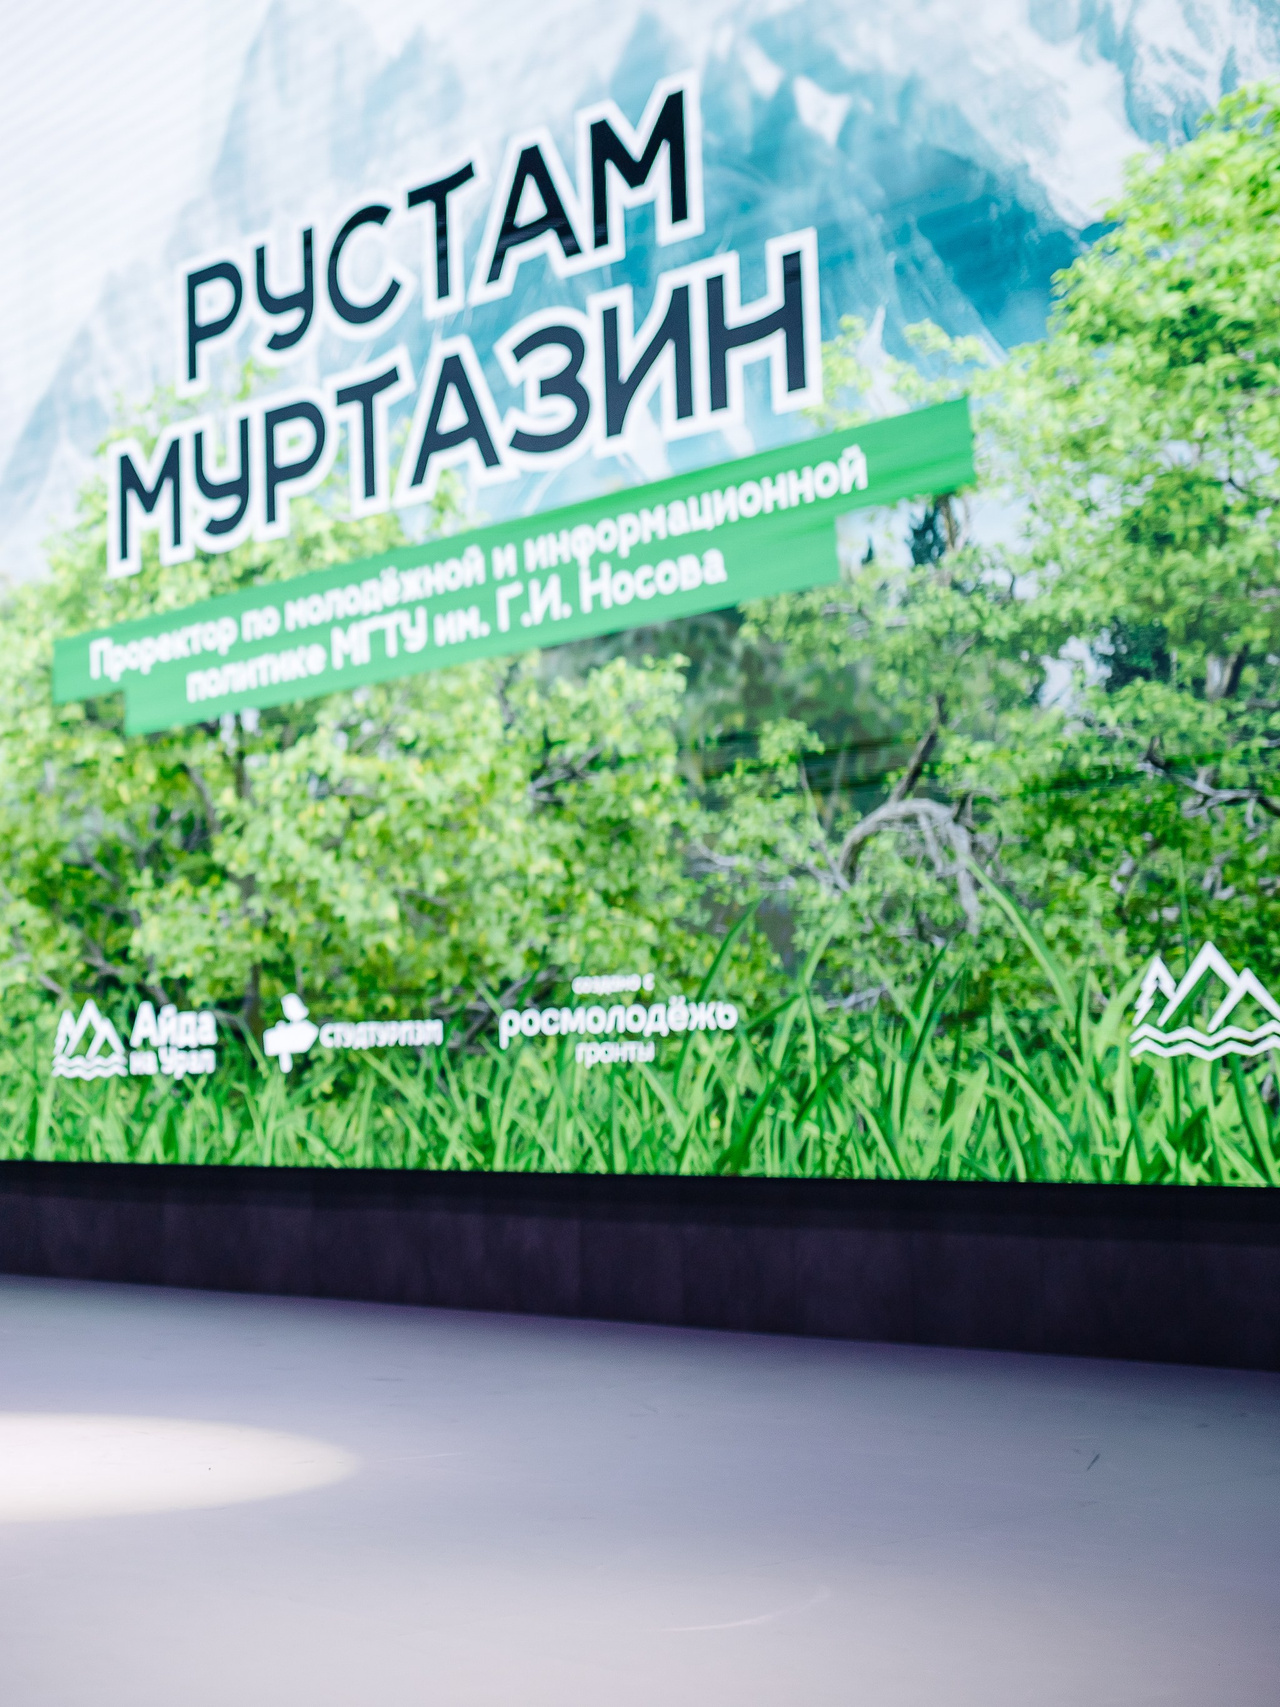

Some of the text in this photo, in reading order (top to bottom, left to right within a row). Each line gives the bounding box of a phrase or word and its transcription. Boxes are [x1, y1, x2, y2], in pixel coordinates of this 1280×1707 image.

[186, 88, 688, 381] РУСТАМ
[120, 250, 806, 561] МУРТАЗИН
[89, 444, 868, 682] Проректор по молодёжной и информационной
[186, 548, 728, 703] политике МГТУ им. Г.И. Носова
[130, 1000, 218, 1048] Айда
[499, 995, 738, 1050] росмолодёжь
